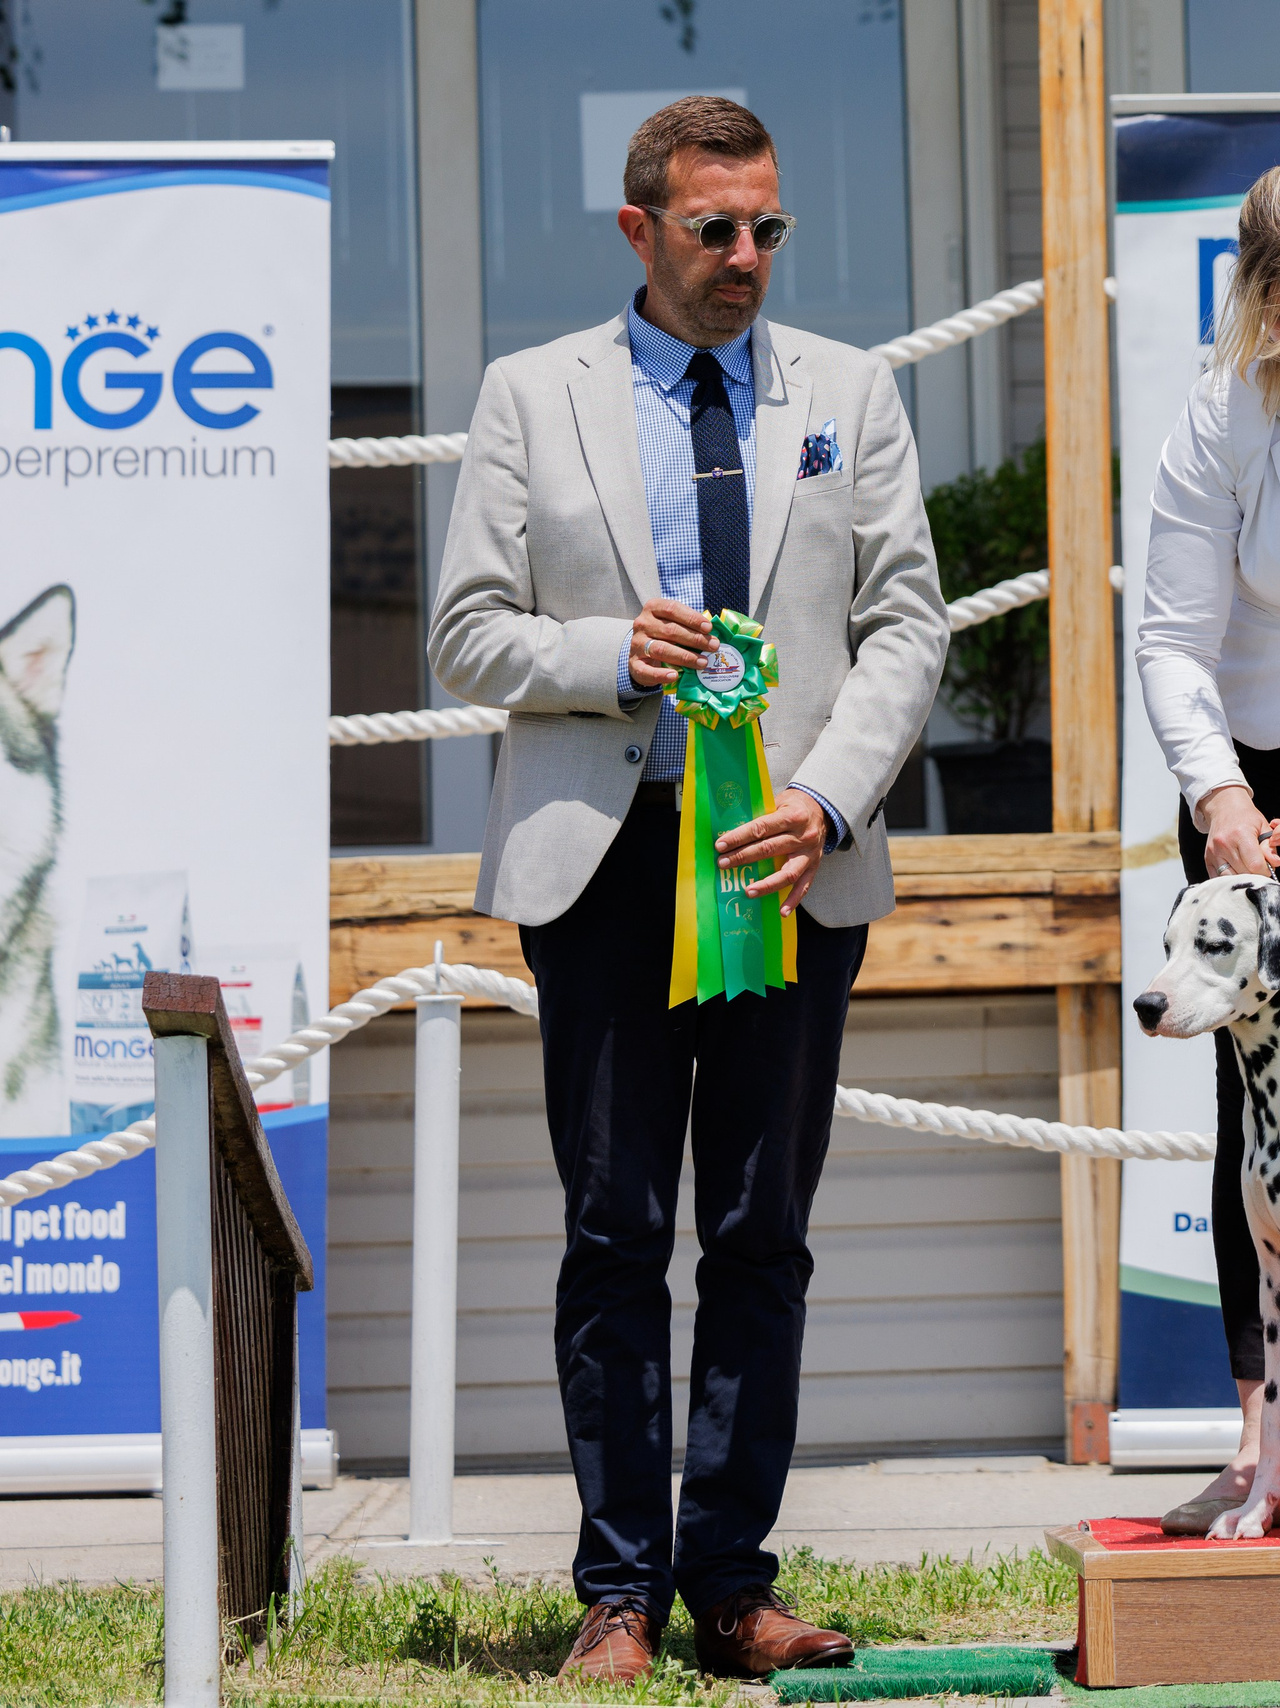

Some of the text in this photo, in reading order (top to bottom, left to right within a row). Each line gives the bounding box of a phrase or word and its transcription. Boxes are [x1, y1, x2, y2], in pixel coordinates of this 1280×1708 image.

[720, 865, 755, 893] BIG
[14, 1204, 61, 1248] pet
[63, 1200, 127, 1241] food
[26, 1254, 121, 1294] mondo
[0, 1350, 82, 1393] onge.it
